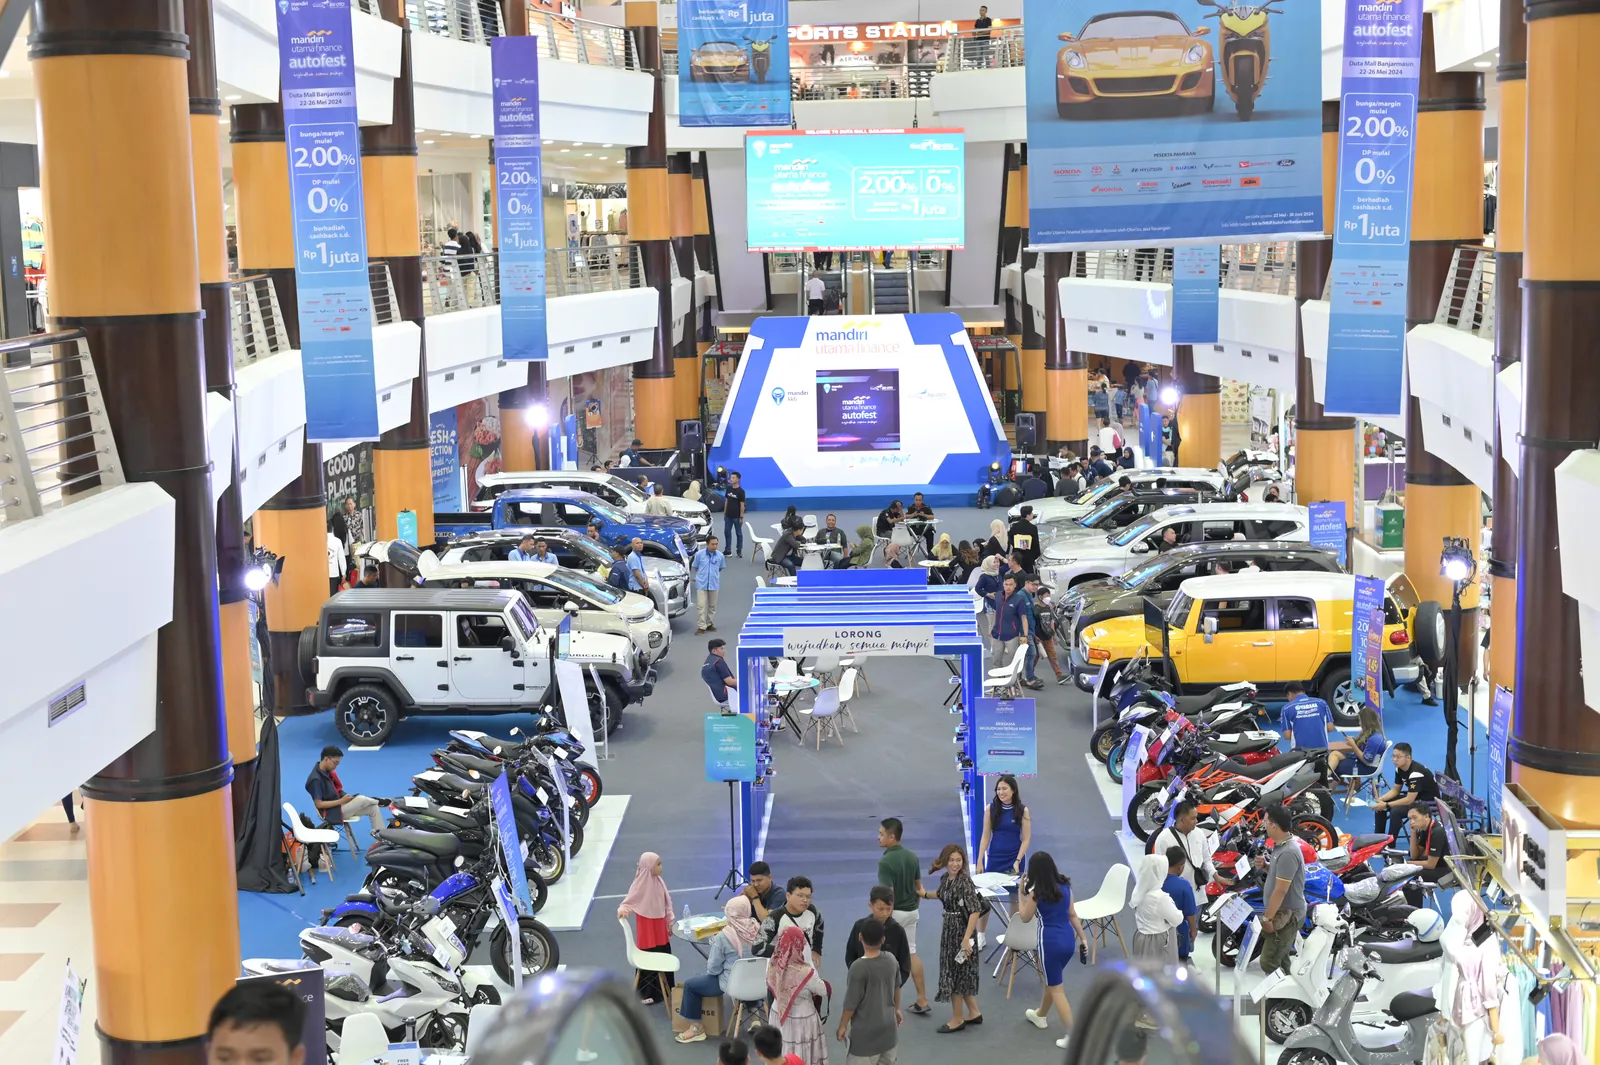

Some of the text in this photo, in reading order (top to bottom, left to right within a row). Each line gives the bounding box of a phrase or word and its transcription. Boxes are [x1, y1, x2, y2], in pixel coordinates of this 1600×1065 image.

[728, 4, 774, 24] Rp 1 juta
[1359, 3, 1393, 13] mandiri
[1358, 11, 1411, 21] utama finance
[788, 24, 957, 40] PORTS STATION
[1353, 23, 1413, 37] autofest
[291, 35, 324, 44] mandiri
[292, 43, 342, 53] utama finance
[289, 54, 347, 69] autofest
[1377, 60, 1414, 69] Banjarmasin
[317, 91, 351, 100] Banjarmasin
[1356, 101, 1401, 110] bunga/margin
[499, 112, 534, 122] autofest
[1346, 116, 1409, 138] 2,00%
[300, 130, 345, 138] bunga/margin
[294, 146, 356, 168] 2,00%
[501, 172, 537, 185] 2,00%
[1344, 214, 1399, 239] Rp 1 juta
[512, 233, 520, 247] 1
[520, 237, 538, 251] juta
[303, 242, 359, 267] Rp 1 juta
[816, 328, 868, 341] mandiri
[815, 344, 851, 355] utama
[842, 410, 878, 420] autofest
[430, 430, 449, 445] ESH
[327, 452, 355, 477] GOOD
[327, 475, 357, 499] PLACE
[1312, 522, 1343, 532] autofest
[834, 630, 882, 640] LORONG
[787, 638, 930, 655] wujudkan semua mimpi
